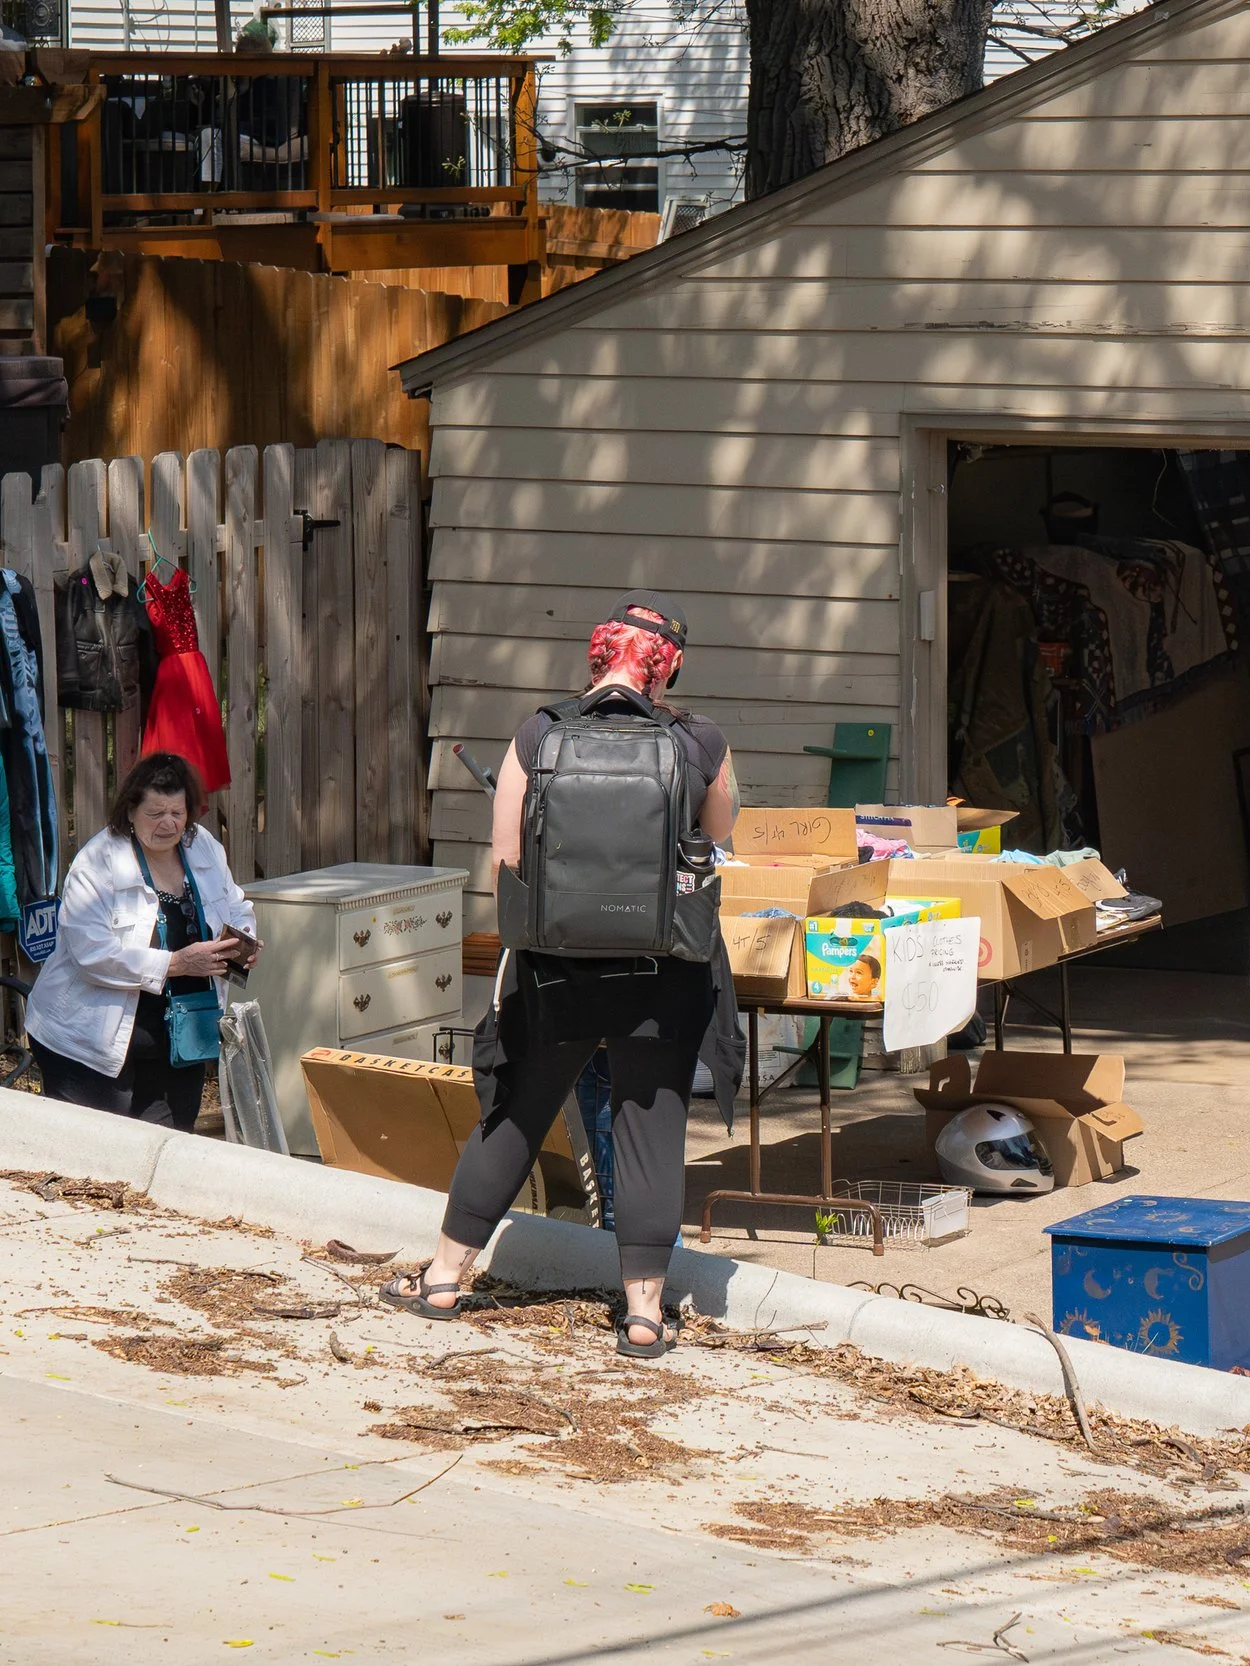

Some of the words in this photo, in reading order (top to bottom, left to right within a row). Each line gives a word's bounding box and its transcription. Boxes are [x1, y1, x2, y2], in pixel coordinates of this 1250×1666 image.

[790, 816, 832, 843] GIRL
[676, 874, 692, 883] TECT
[600, 904, 646, 913] NOMATIC
[26, 905, 56, 939] ADT
[732, 927, 771, 951] 4T/5
[822, 943, 857, 958] Pampers
[892, 935, 924, 963] KIDS
[338, 1054, 472, 1078] BASKETCAS
[580, 1153, 600, 1228] BASKET
